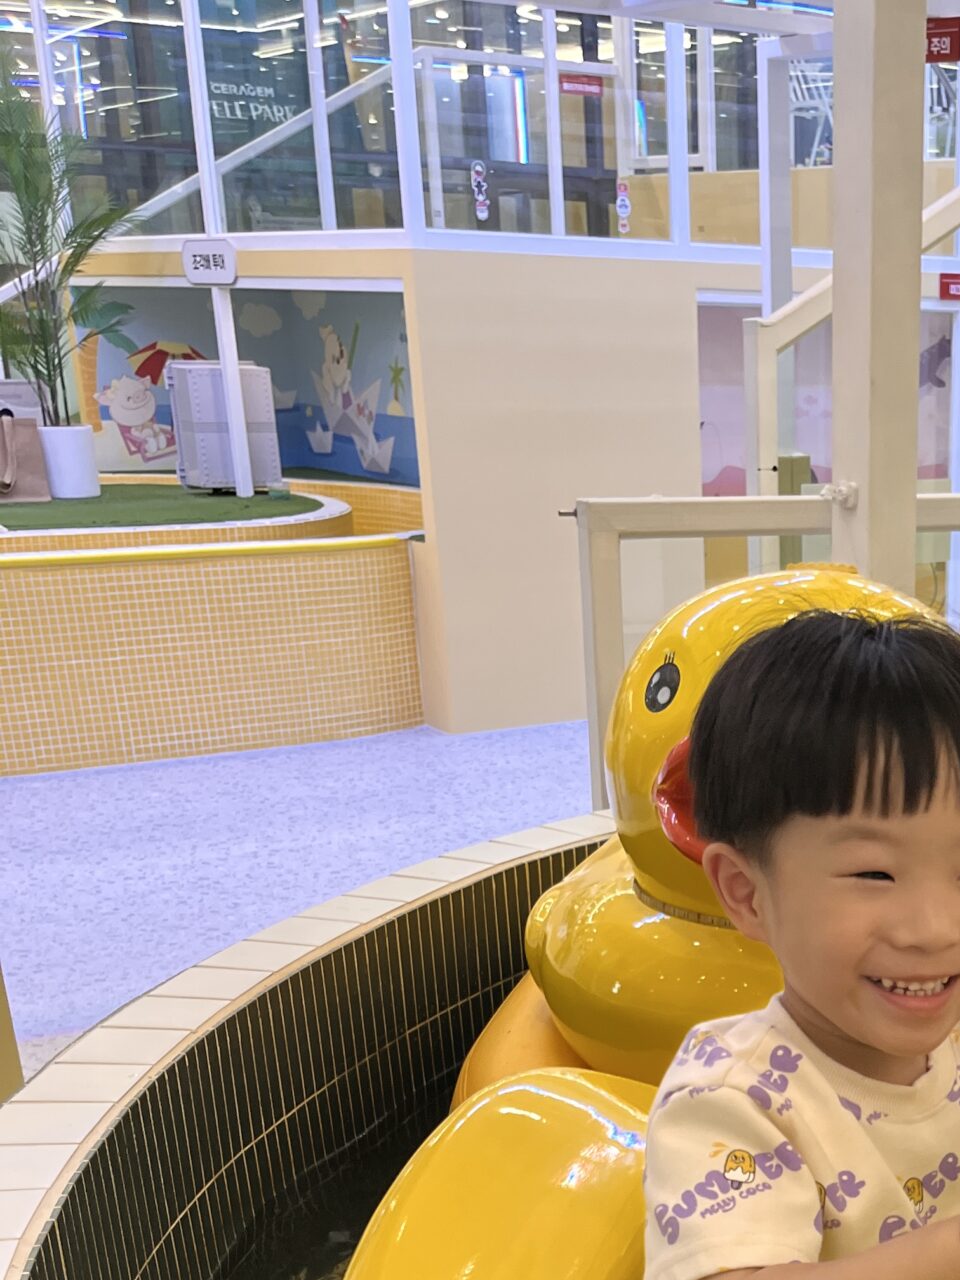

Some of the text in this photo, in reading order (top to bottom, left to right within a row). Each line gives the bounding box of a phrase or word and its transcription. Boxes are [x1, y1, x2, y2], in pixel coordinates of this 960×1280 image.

[929, 36, 951, 55] 주의
[209, 82, 275, 98] CERAGEM
[210, 100, 297, 122] ELL PARK
